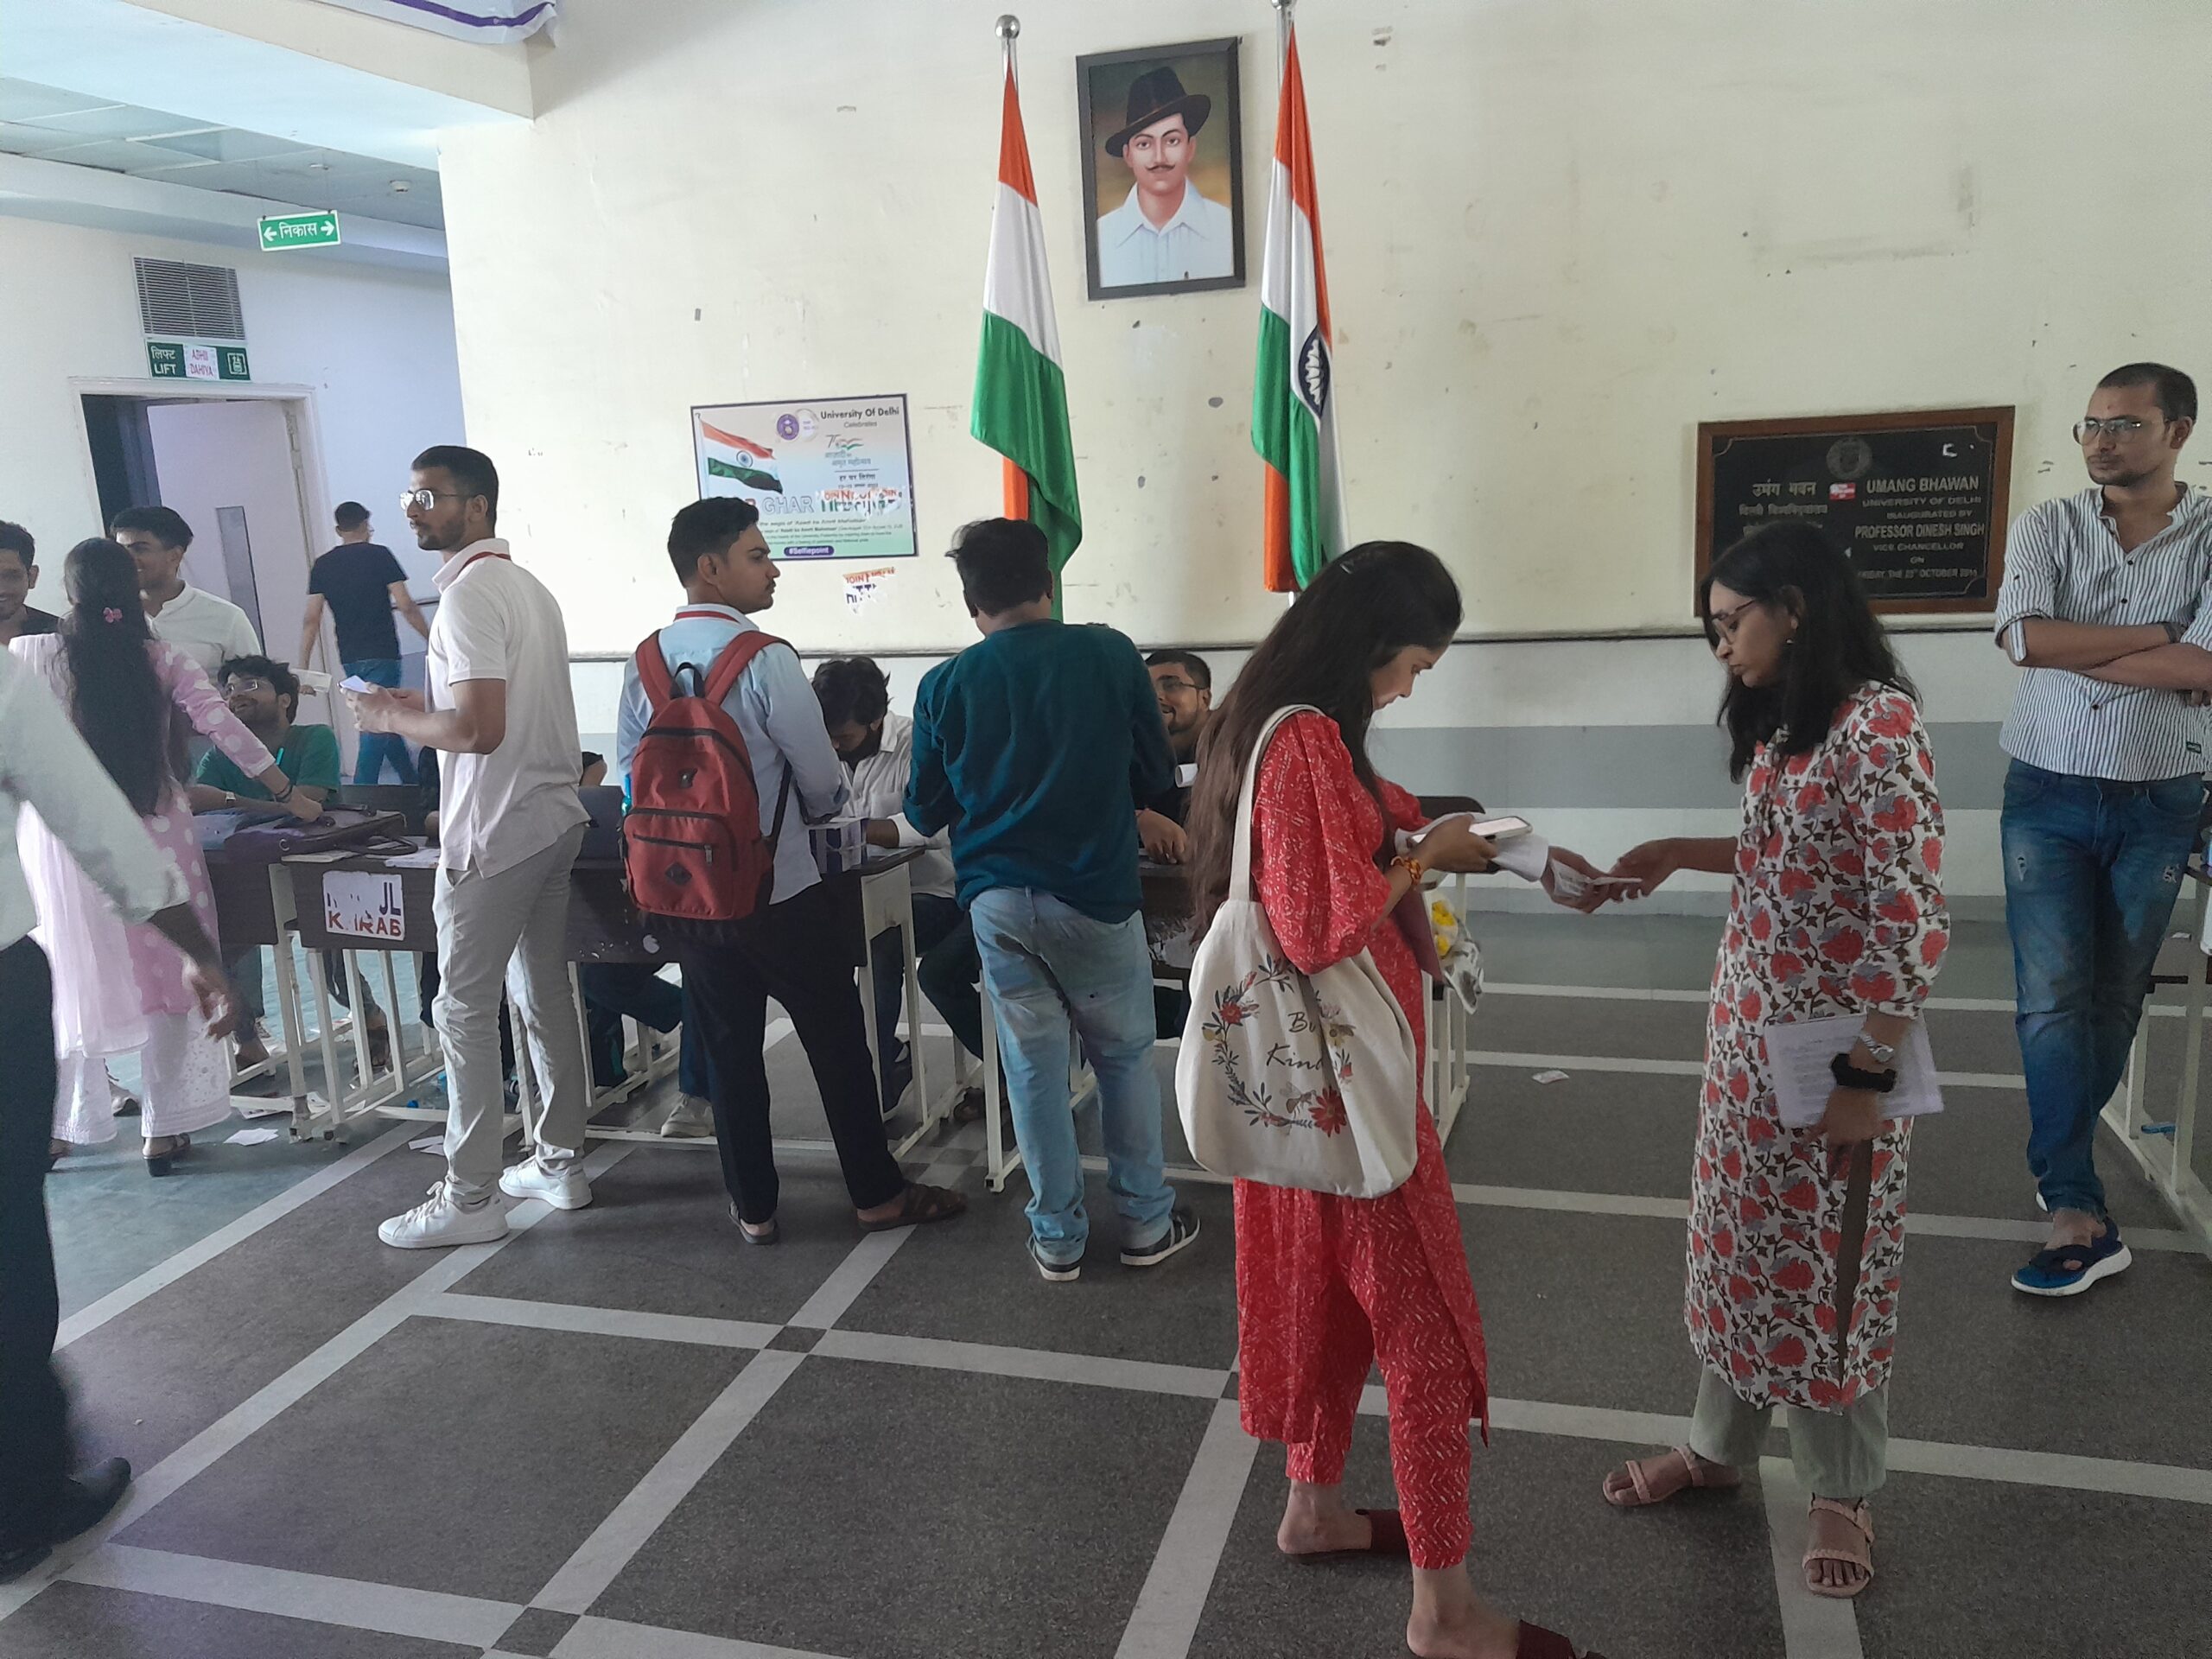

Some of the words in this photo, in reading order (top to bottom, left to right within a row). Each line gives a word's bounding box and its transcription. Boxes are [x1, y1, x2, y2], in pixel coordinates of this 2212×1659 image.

[278, 222, 318, 238] निकास
[150, 346, 176, 360] लिफ्ट
[154, 363, 176, 375] LIFT
[821, 409, 862, 420] University
[865, 408, 876, 416] Of
[878, 406, 899, 416] Delhi
[1789, 481, 1816, 497] भवन
[1866, 478, 1916, 493] UMANG
[1918, 475, 1980, 492] BHAWAN
[762, 495, 815, 515] GHAR
[1862, 497, 1927, 507] UNIVERSITY
[1929, 497, 1943, 505] OF
[1948, 496, 1982, 505] DELHI
[1886, 510, 1957, 519] INAUGURATED
[1854, 524, 1914, 539] PROFESSOR
[1916, 523, 1952, 537] DINESH
[1953, 523, 1985, 537] SINGH
[1897, 542, 1964, 551] CHANCELLOR
[1910, 556, 1925, 564] ON
